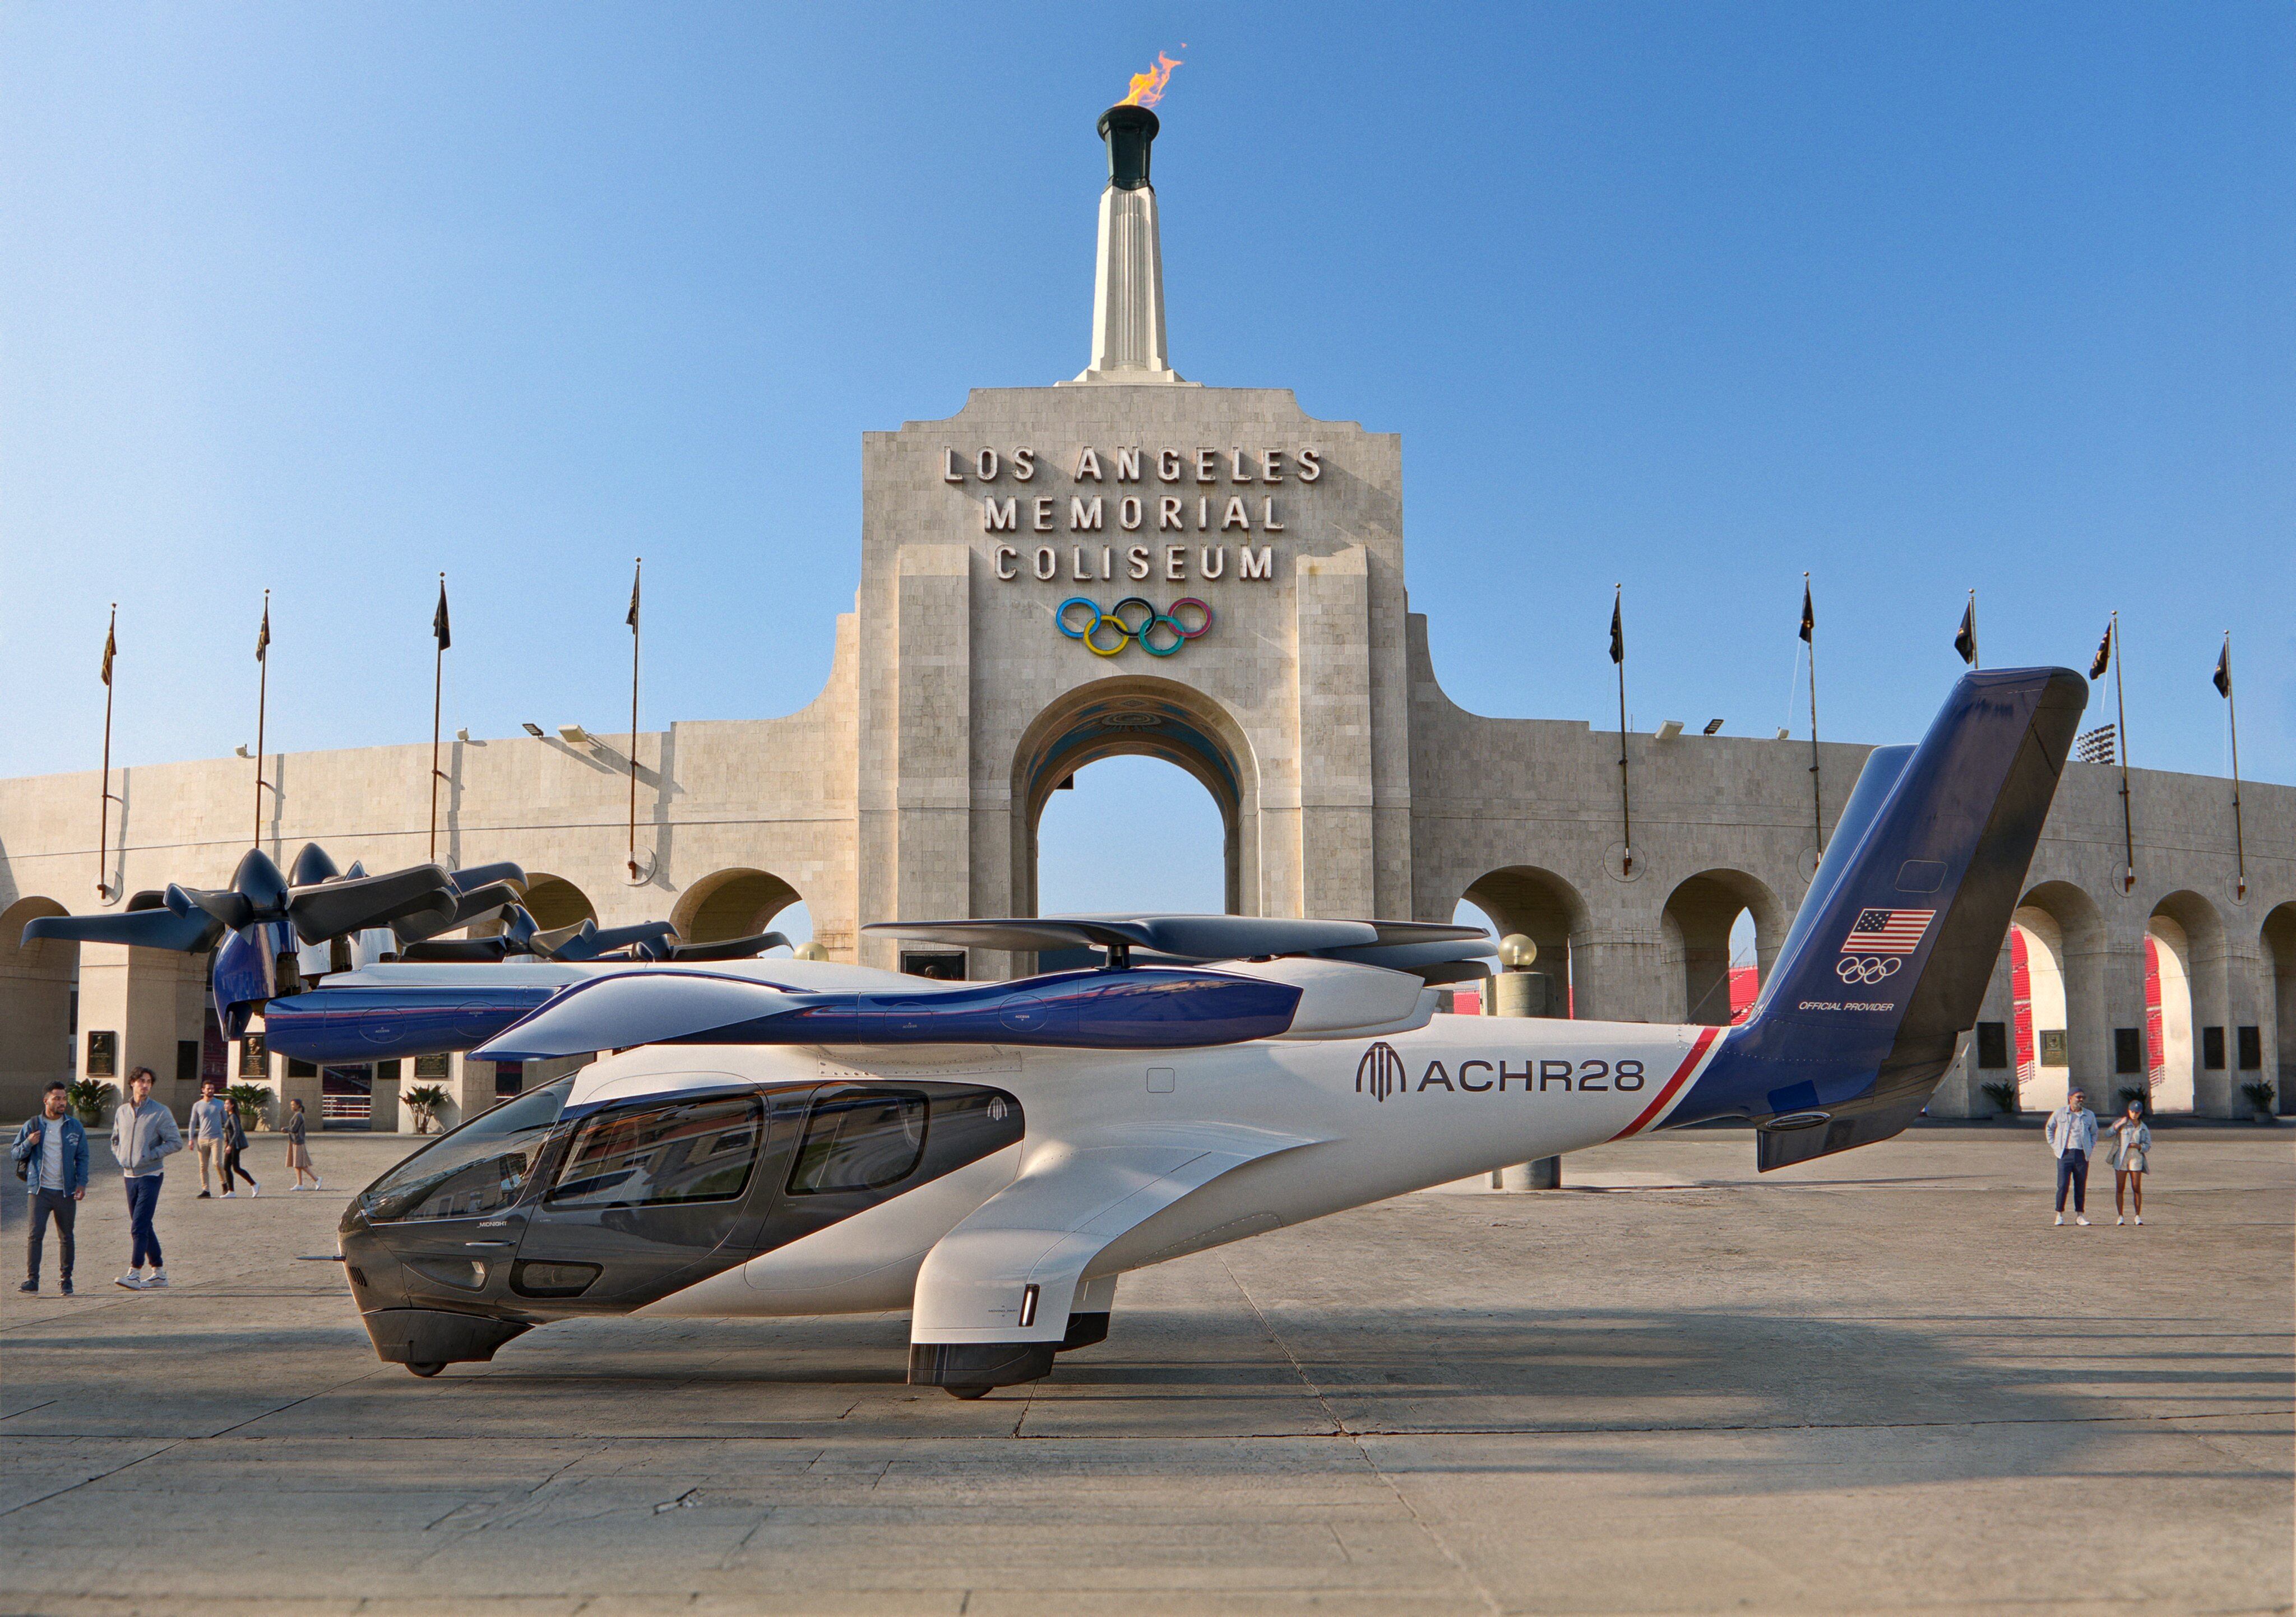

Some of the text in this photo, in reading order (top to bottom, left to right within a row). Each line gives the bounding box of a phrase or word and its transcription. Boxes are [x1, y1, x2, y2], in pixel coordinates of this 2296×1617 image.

[944, 446, 1320, 483] LOS ANGELES
[984, 495, 1284, 532] MEMORIAL
[994, 544, 1272, 581] COLISEUM
[1798, 1001, 1895, 1011] OFFICIAL PROVIDER
[1417, 1059, 1645, 1092] ACHR28
